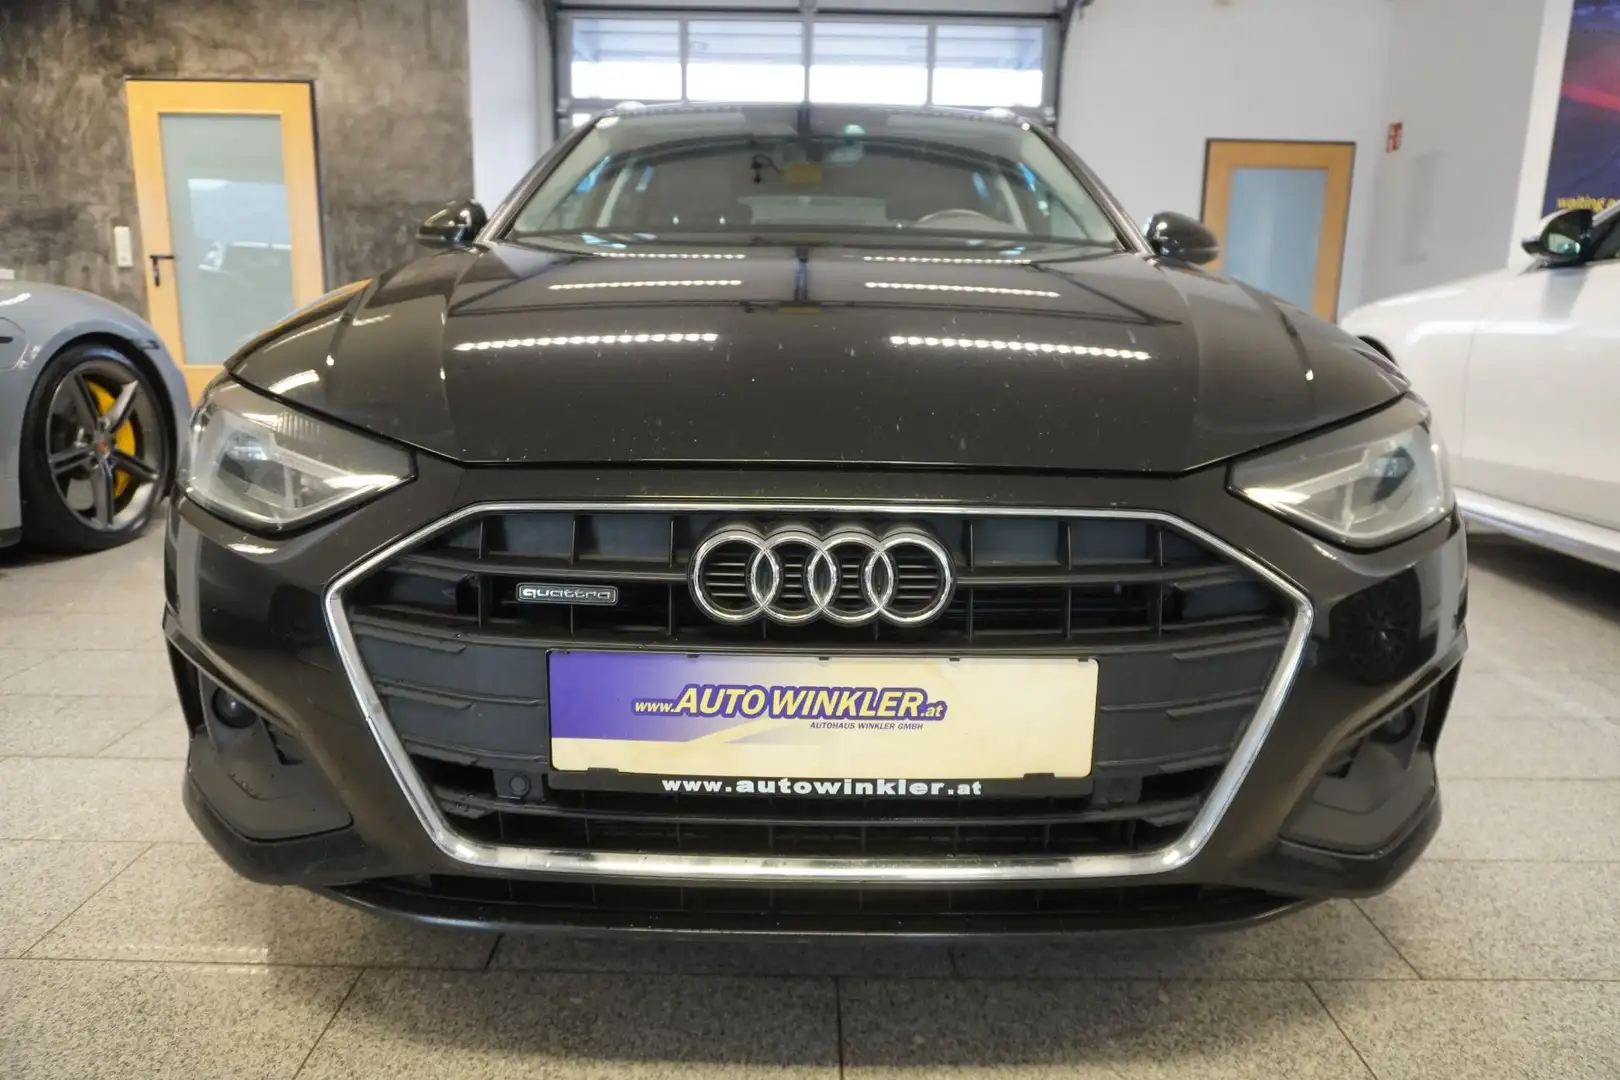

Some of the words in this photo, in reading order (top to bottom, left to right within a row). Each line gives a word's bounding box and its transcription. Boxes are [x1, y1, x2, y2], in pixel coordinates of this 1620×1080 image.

[522, 588, 611, 599] quattro
[810, 721, 855, 730] AUTOHAUS
[858, 722, 895, 731] WINKLER
[897, 723, 924, 731] GMBH
[662, 778, 982, 795] www.autowinkler.at
